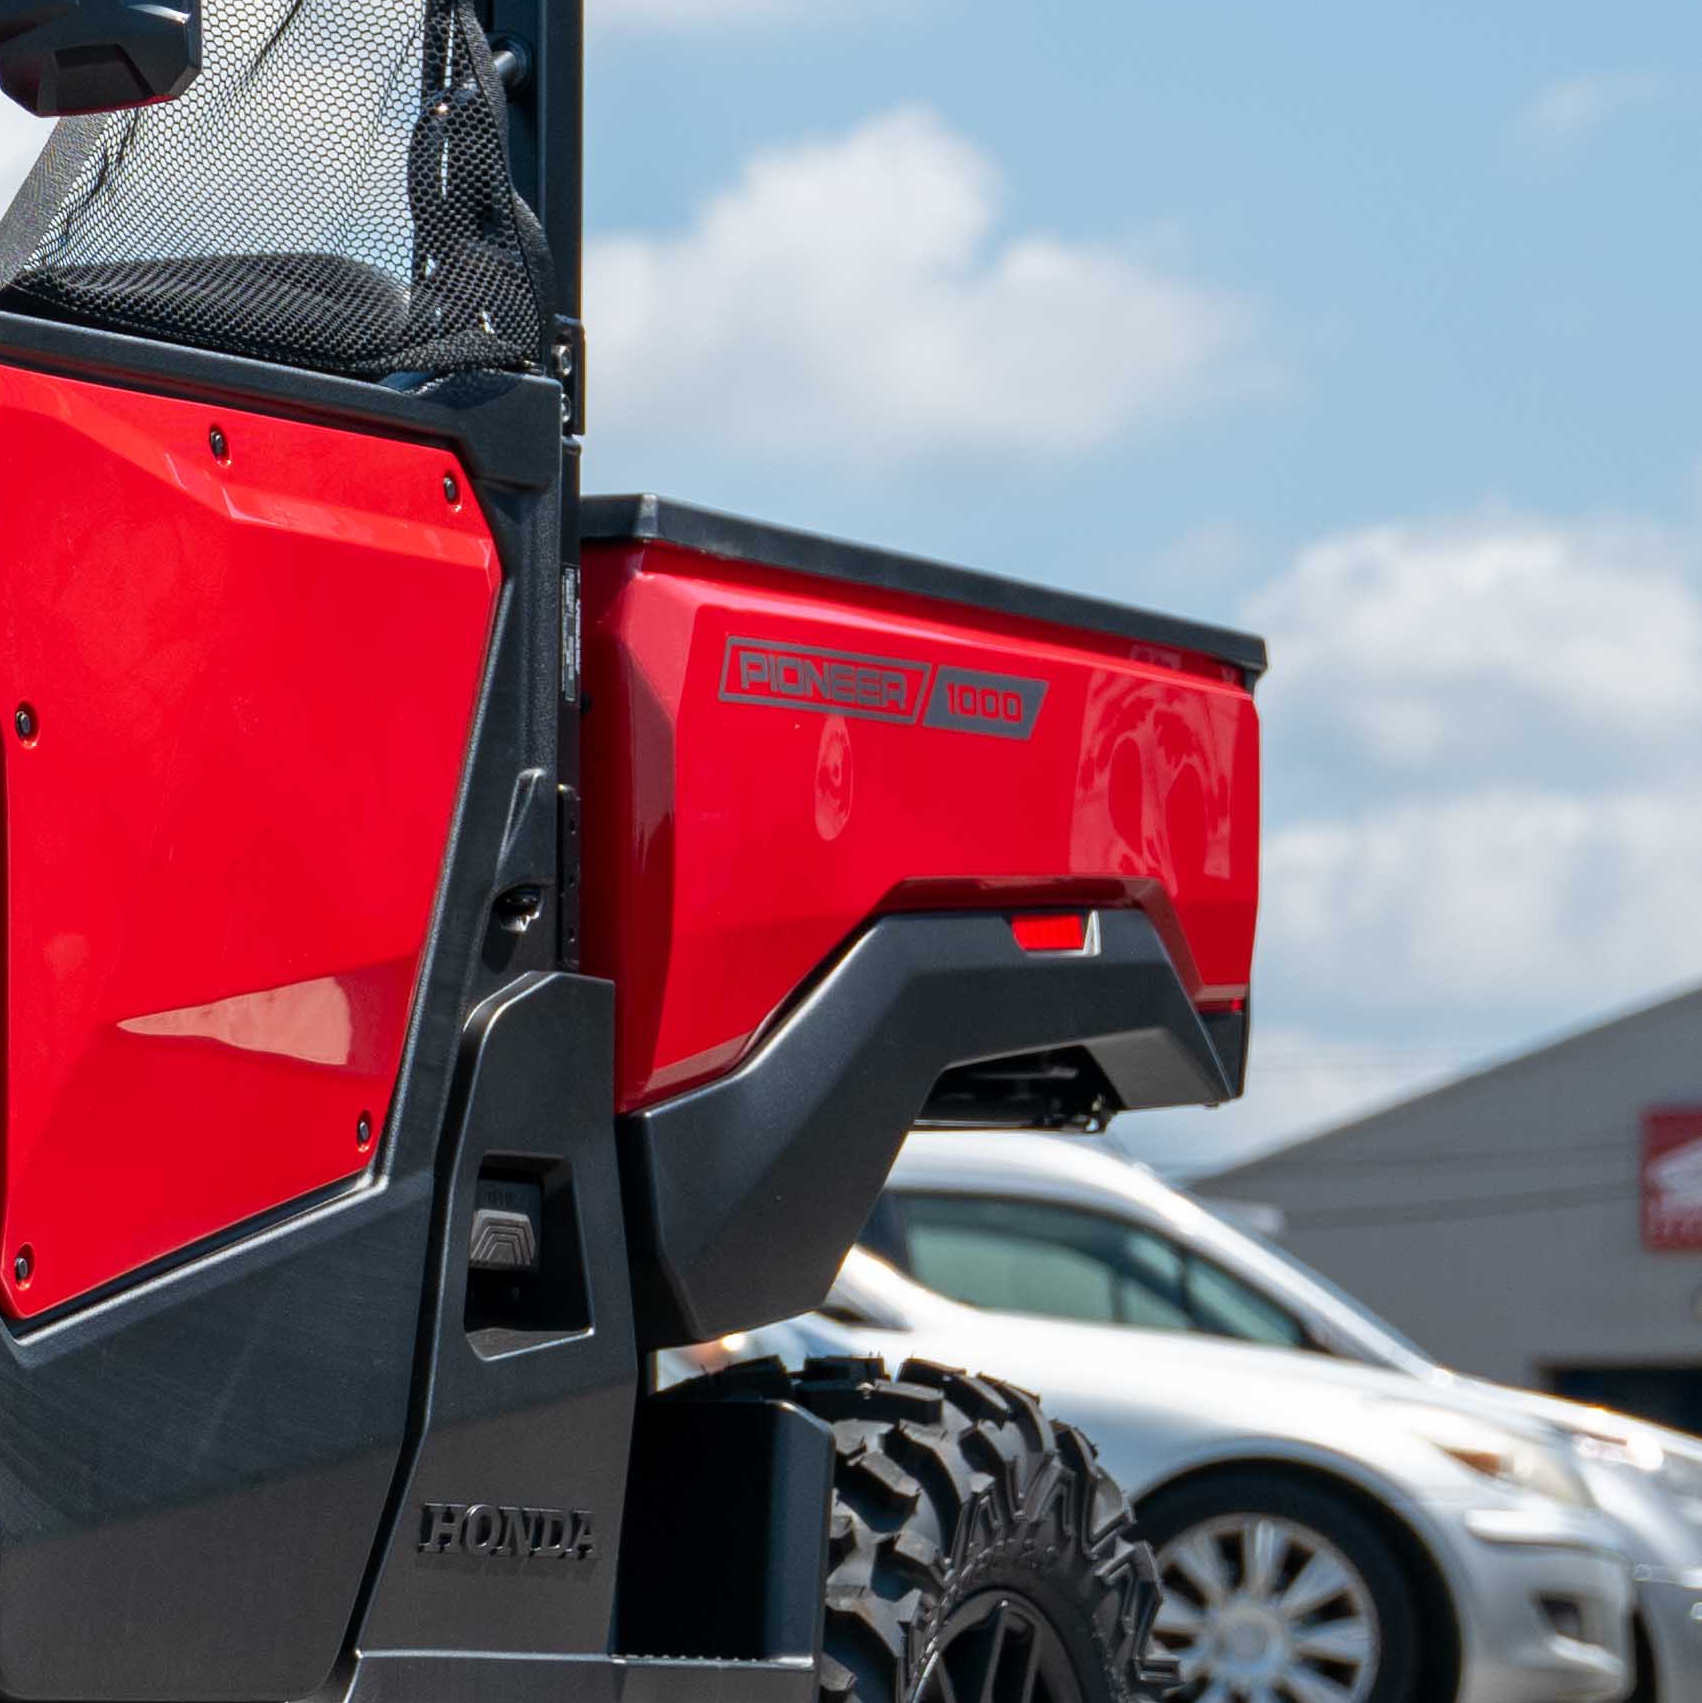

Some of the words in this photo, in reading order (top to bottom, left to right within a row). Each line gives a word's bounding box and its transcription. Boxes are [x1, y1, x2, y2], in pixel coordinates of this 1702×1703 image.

[738, 649, 908, 711] PIONEER
[945, 682, 1024, 724] 1000
[416, 1502, 602, 1561] HONDA
